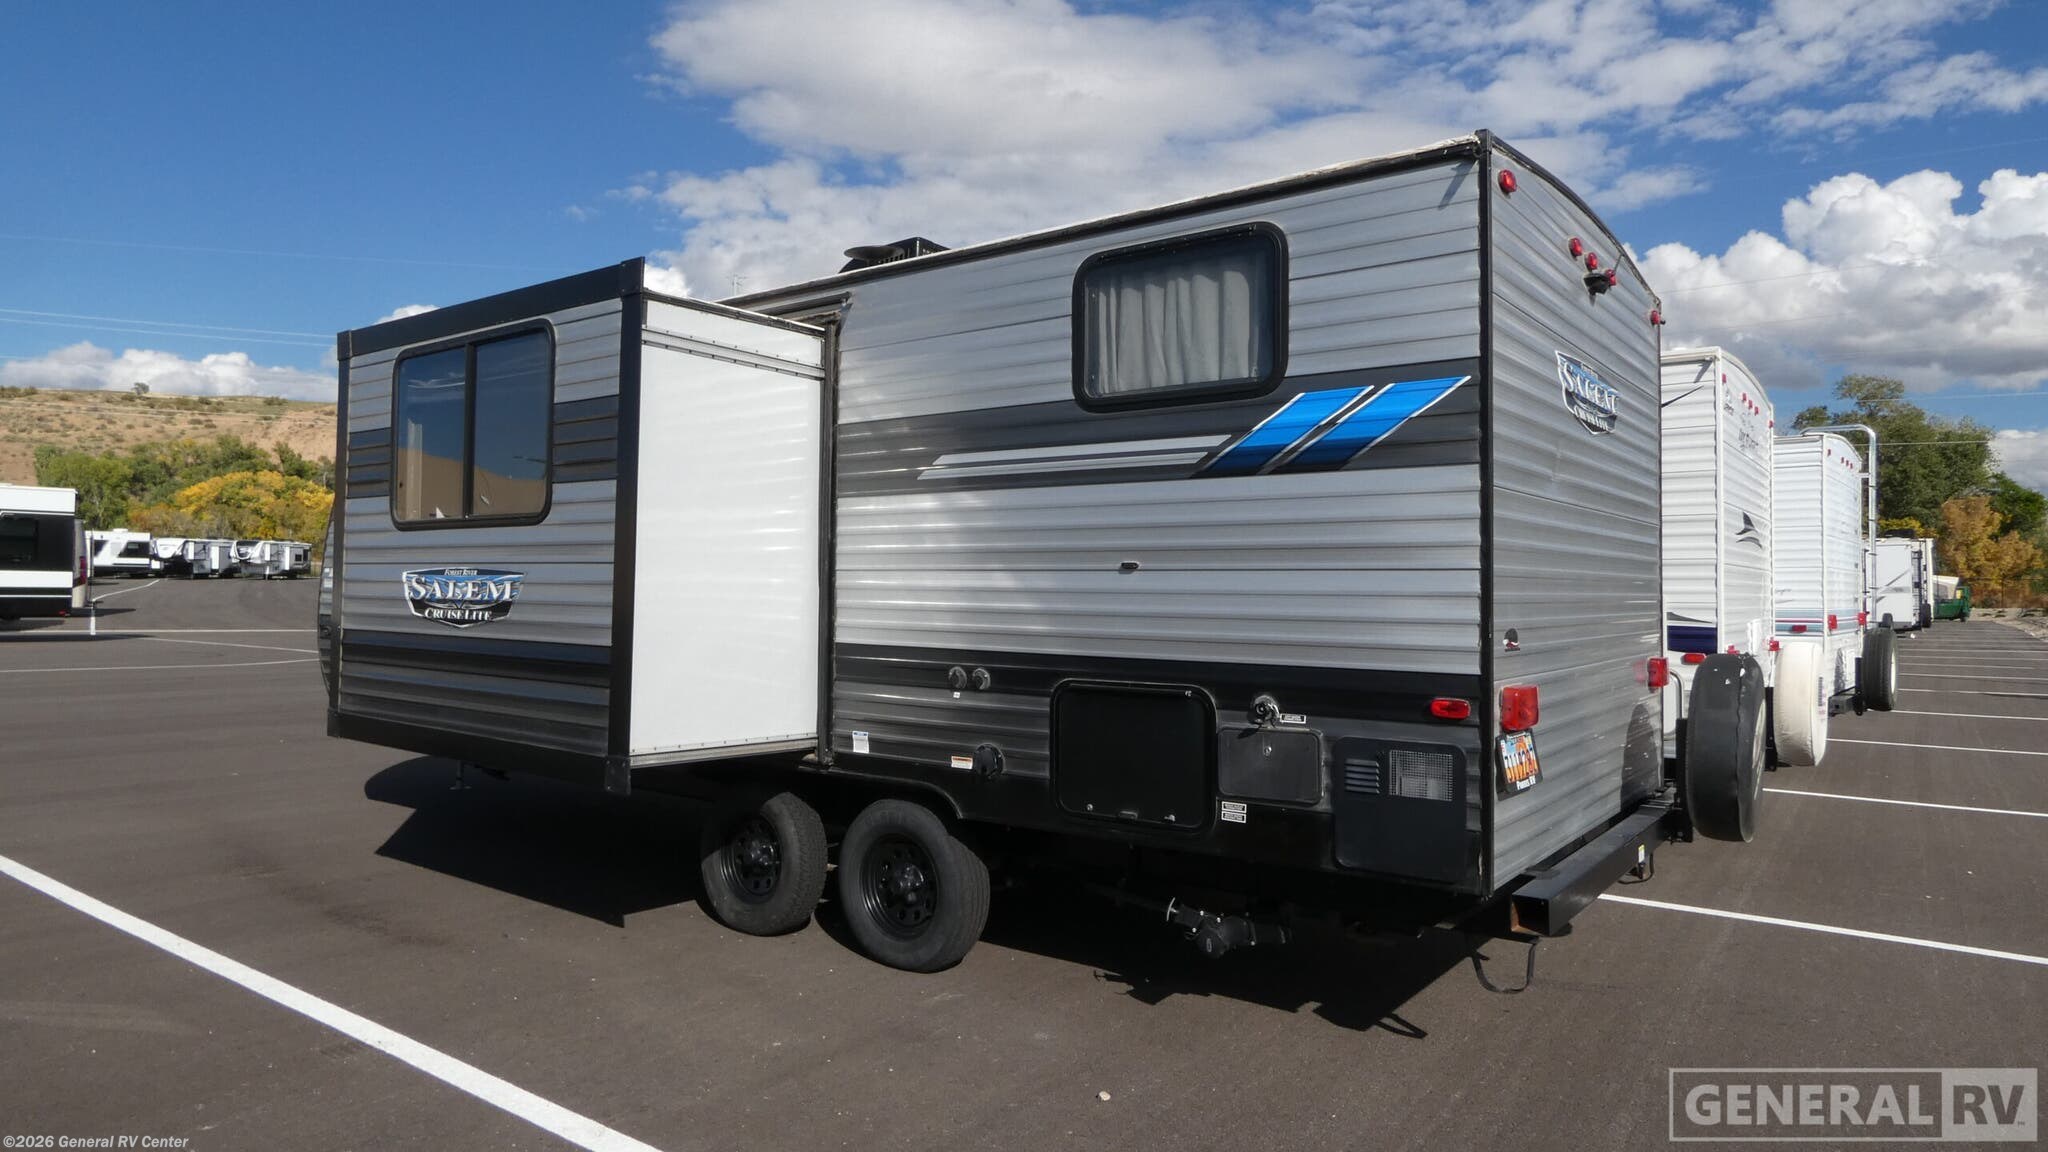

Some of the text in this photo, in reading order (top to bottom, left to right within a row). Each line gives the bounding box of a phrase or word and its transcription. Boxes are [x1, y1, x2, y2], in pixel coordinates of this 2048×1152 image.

[1562, 362, 1618, 413] SALEM
[409, 576, 514, 601] SALEM
[424, 607, 492, 621] CRUISELITE
